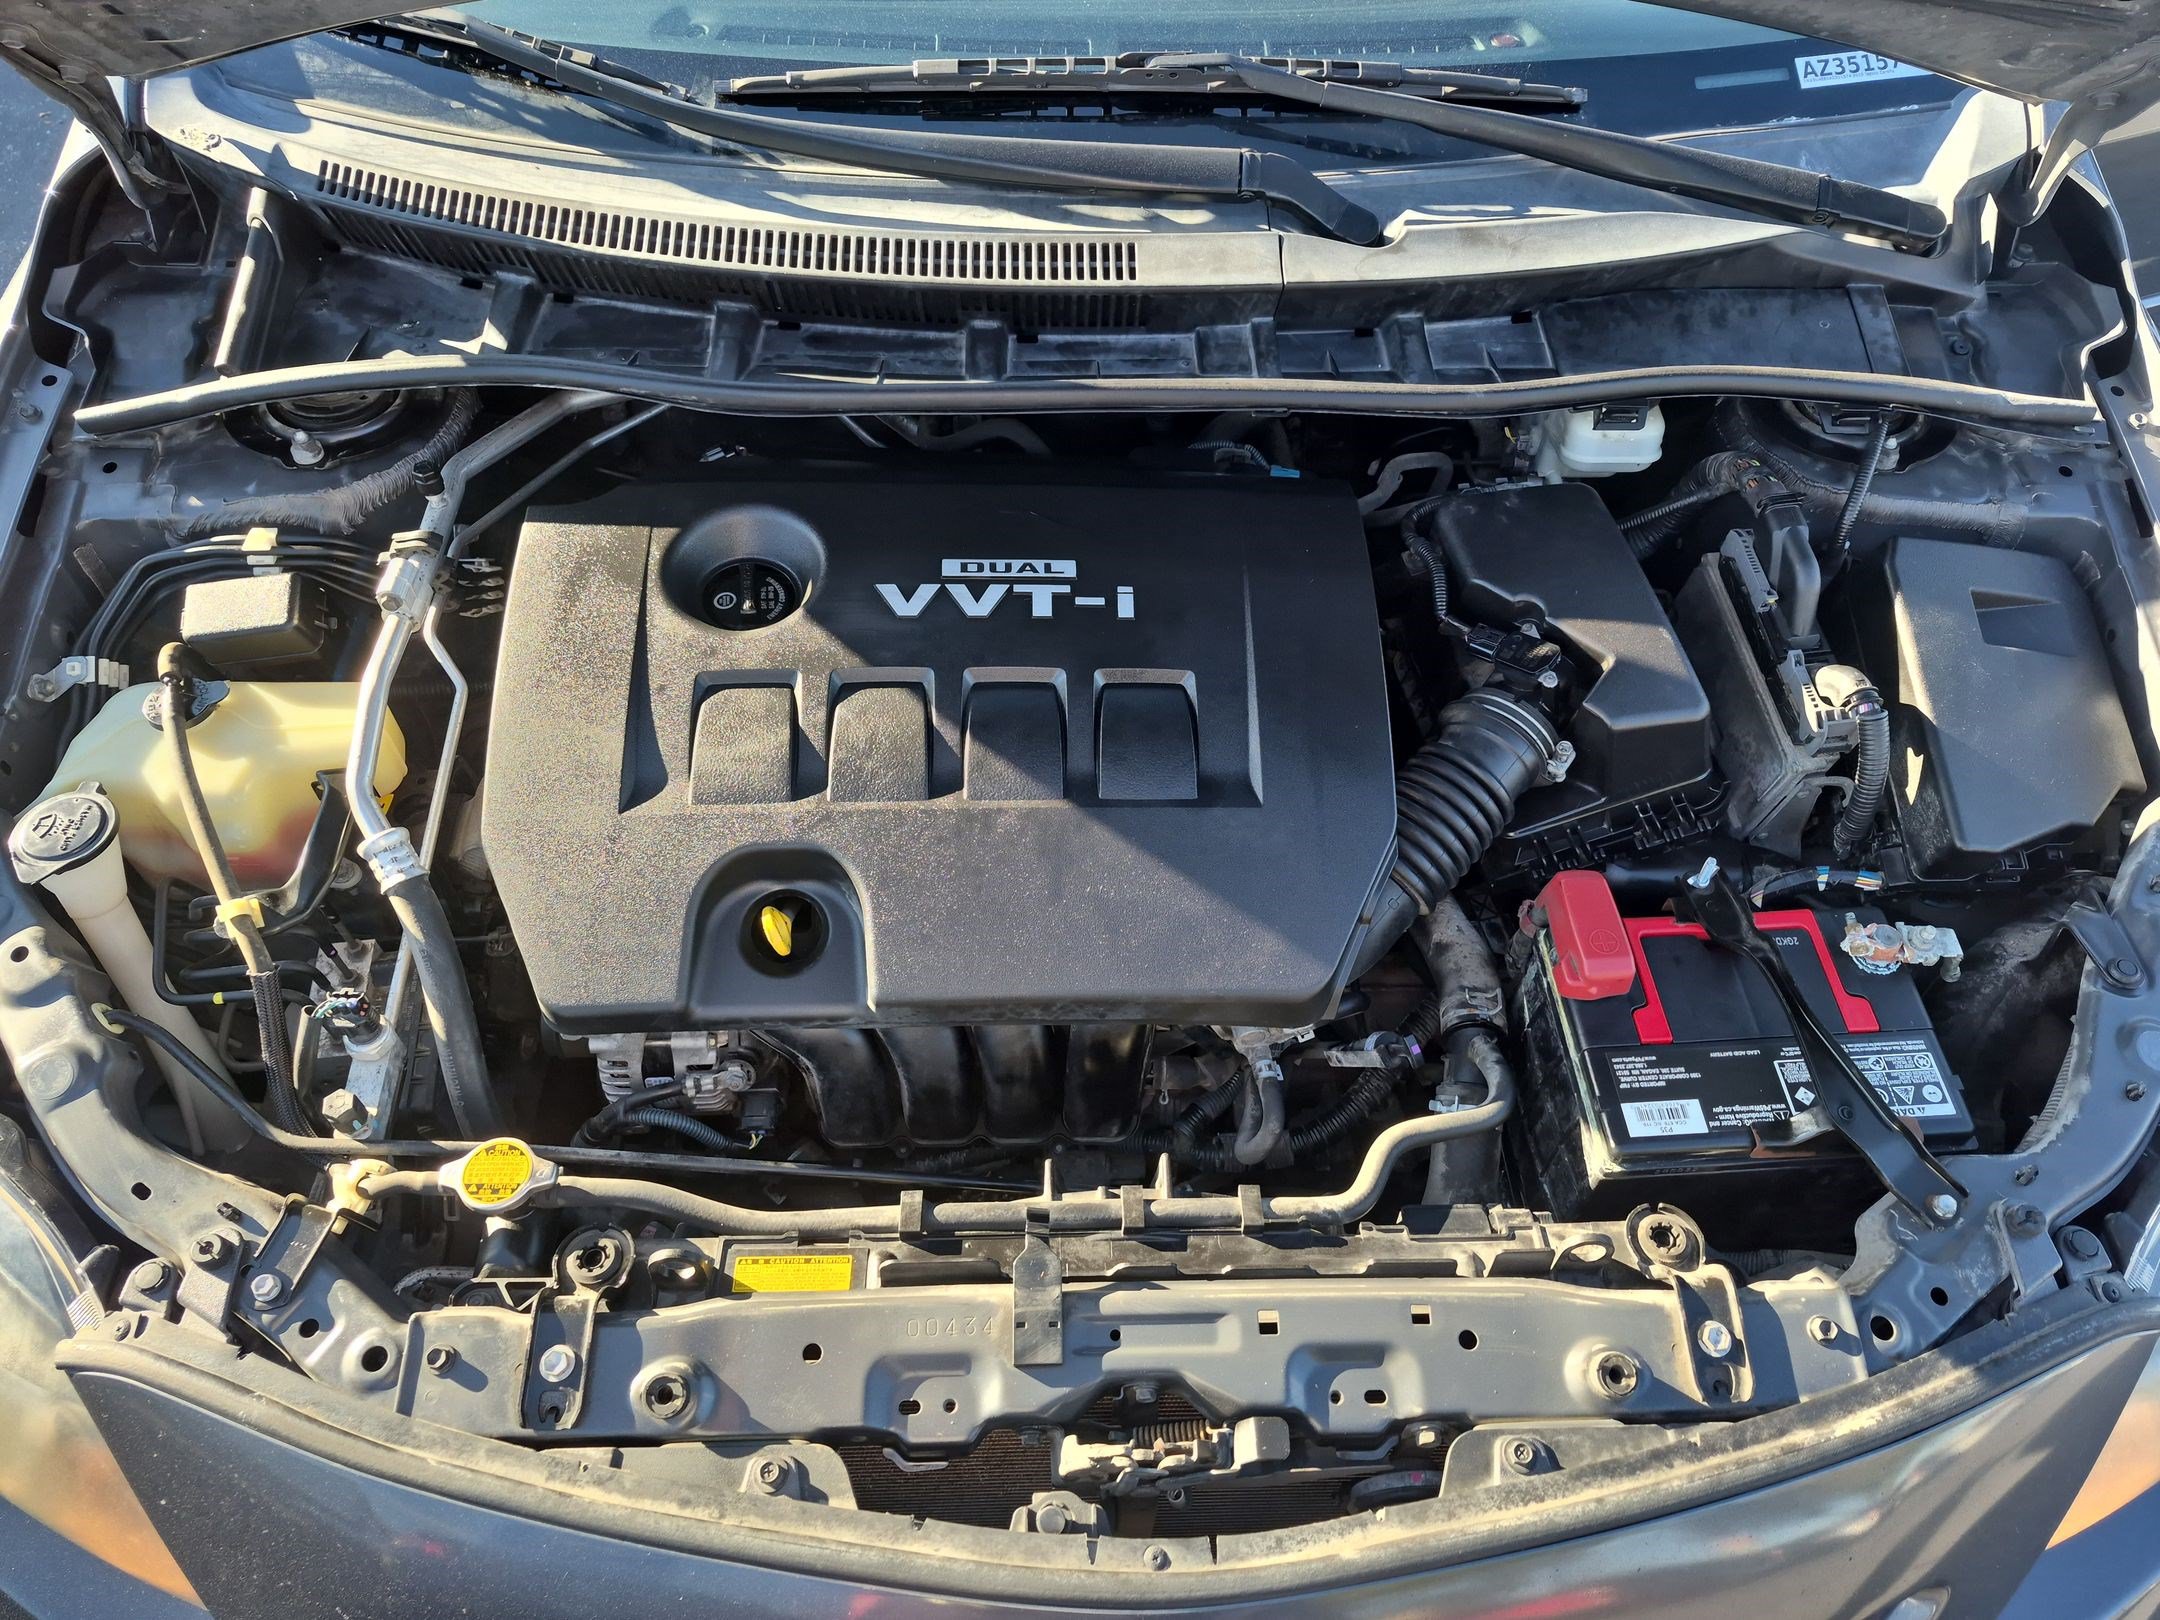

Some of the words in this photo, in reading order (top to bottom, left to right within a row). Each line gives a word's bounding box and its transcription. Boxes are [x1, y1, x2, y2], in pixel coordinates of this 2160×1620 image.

[959, 561, 1065, 574] DUAL
[873, 583, 1136, 620] VVT-i
[1735, 1111, 1774, 1119] Reproductive
[482, 1183, 518, 1191] ATTENTION
[907, 1317, 993, 1337] 00434
